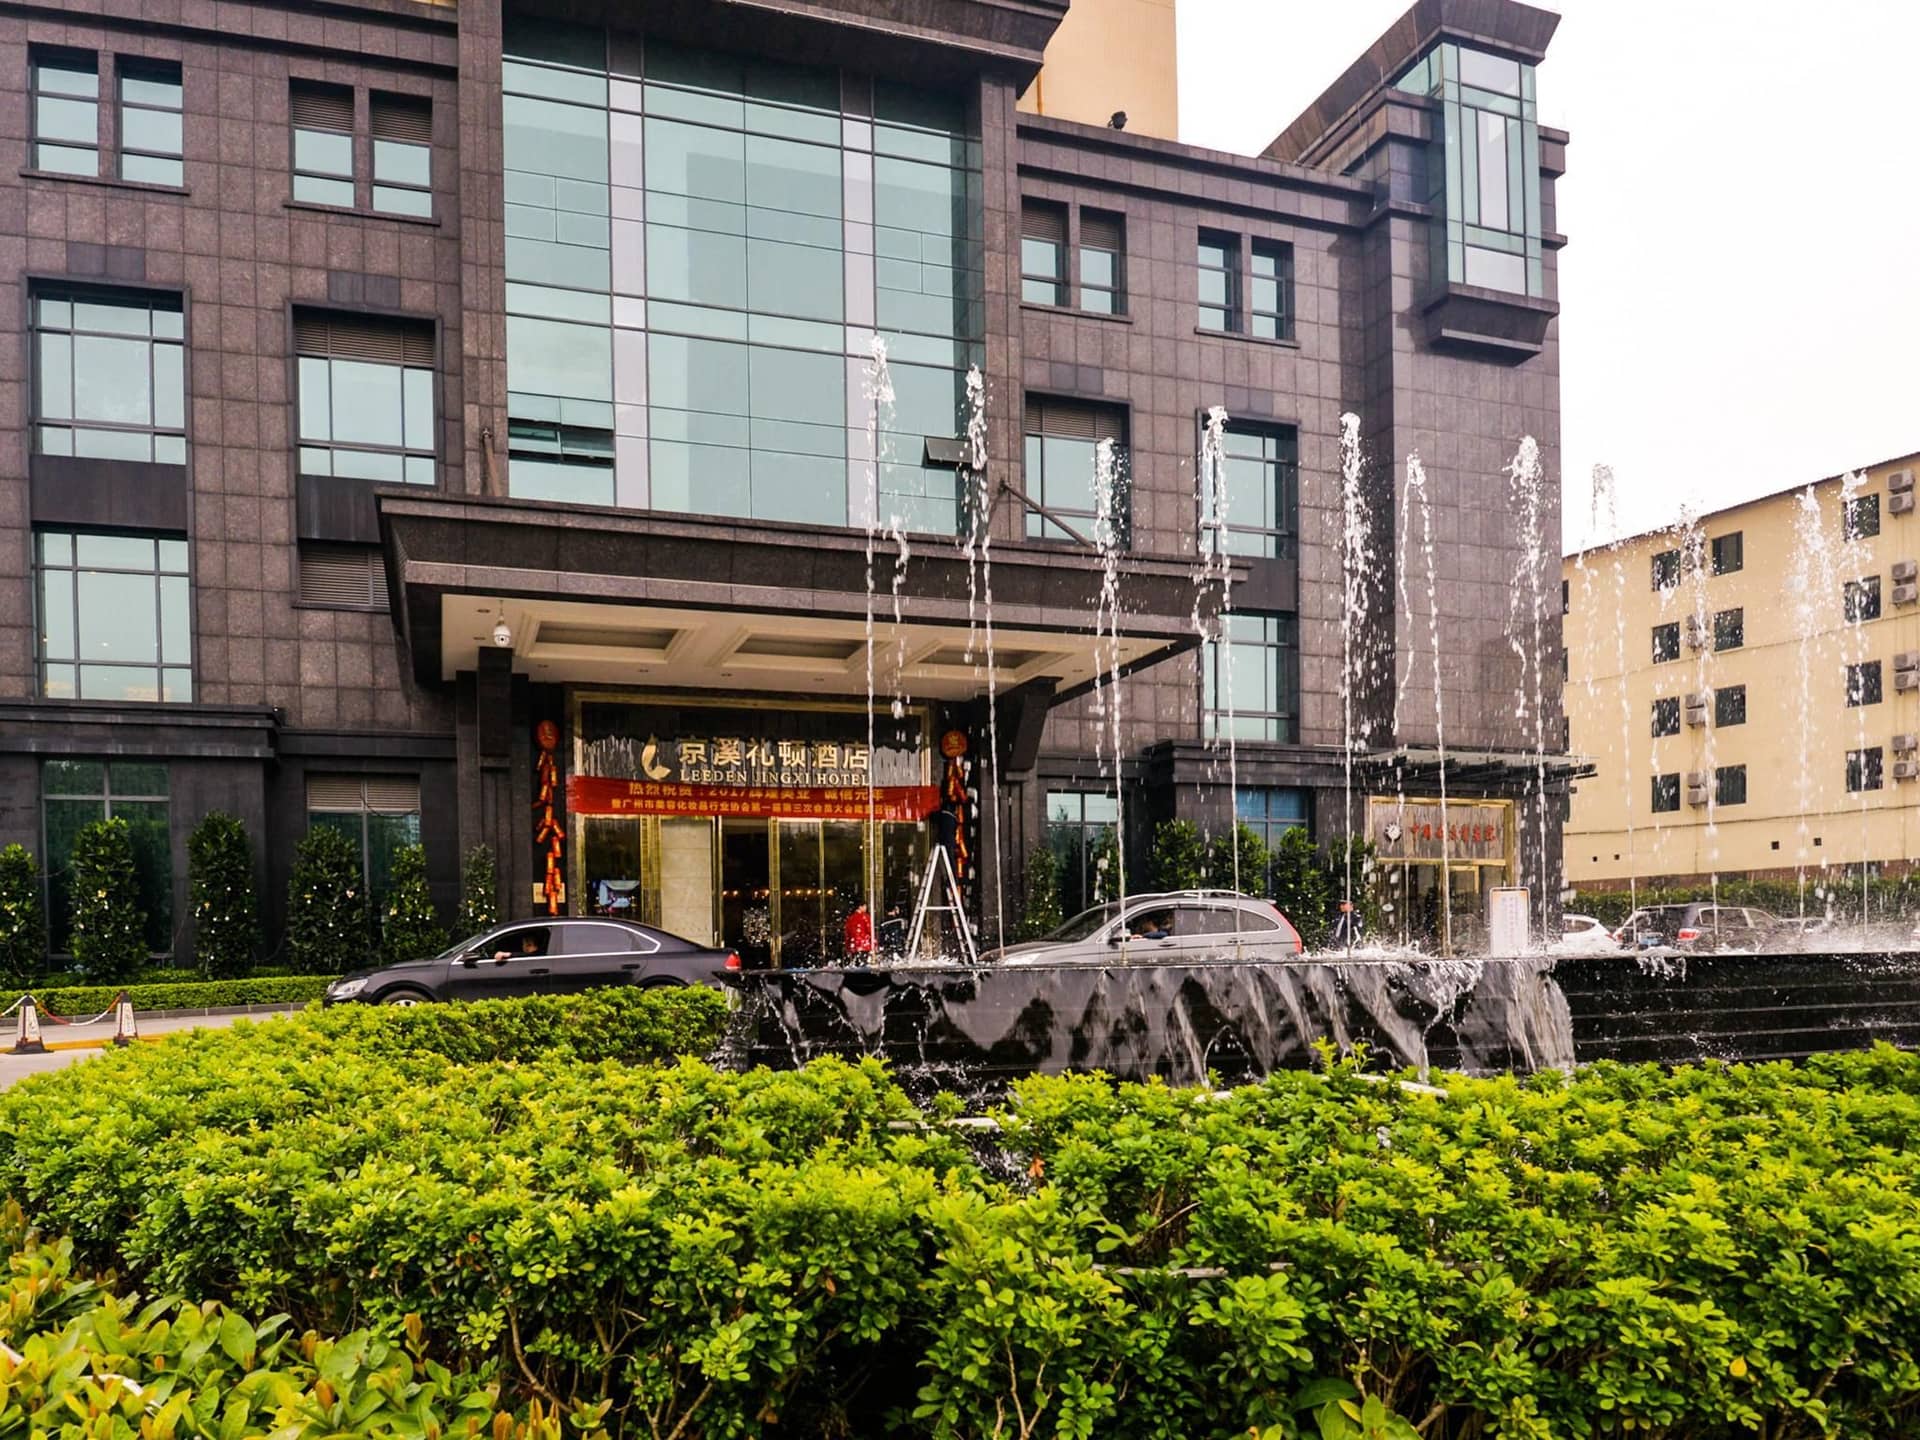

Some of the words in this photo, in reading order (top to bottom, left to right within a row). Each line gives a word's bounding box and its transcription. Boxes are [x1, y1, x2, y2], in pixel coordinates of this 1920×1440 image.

[679, 736, 869, 770] 京溪礼顿酒店
[680, 770, 747, 782] LEEDEN
[755, 771, 810, 784] JINGXI
[816, 773, 871, 786] HOTEL
